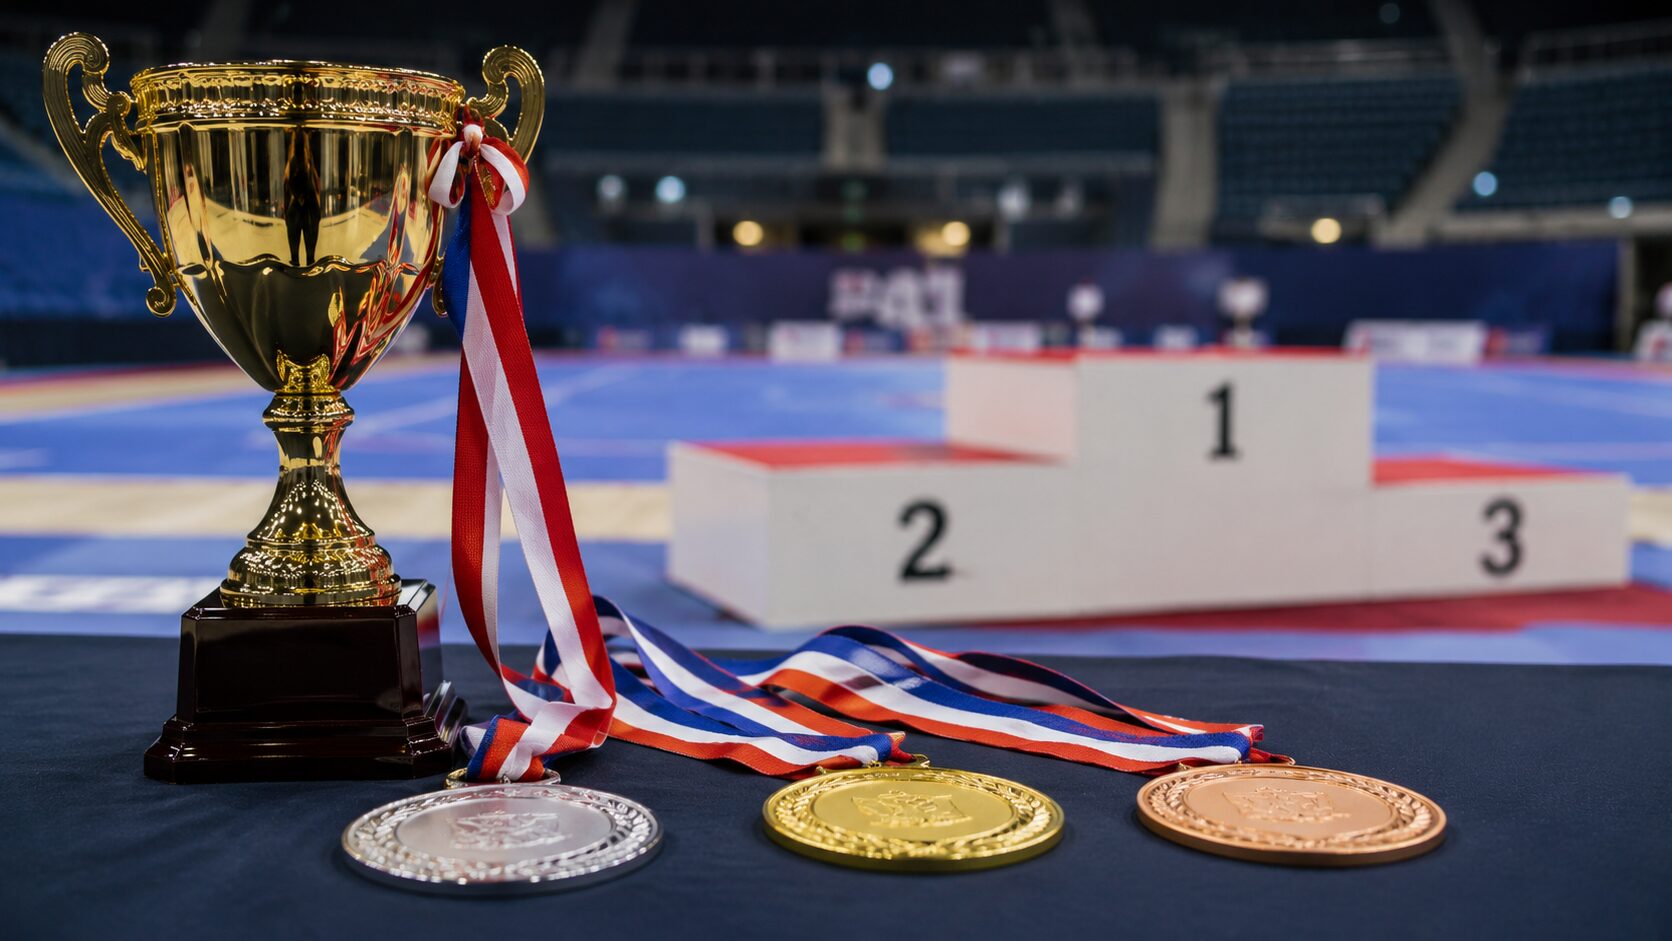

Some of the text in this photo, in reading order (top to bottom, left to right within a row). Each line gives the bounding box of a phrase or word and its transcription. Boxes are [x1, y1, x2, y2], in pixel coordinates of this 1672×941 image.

[1206, 381, 1240, 460] 1
[898, 498, 954, 583] 2
[1480, 497, 1522, 578] 3
